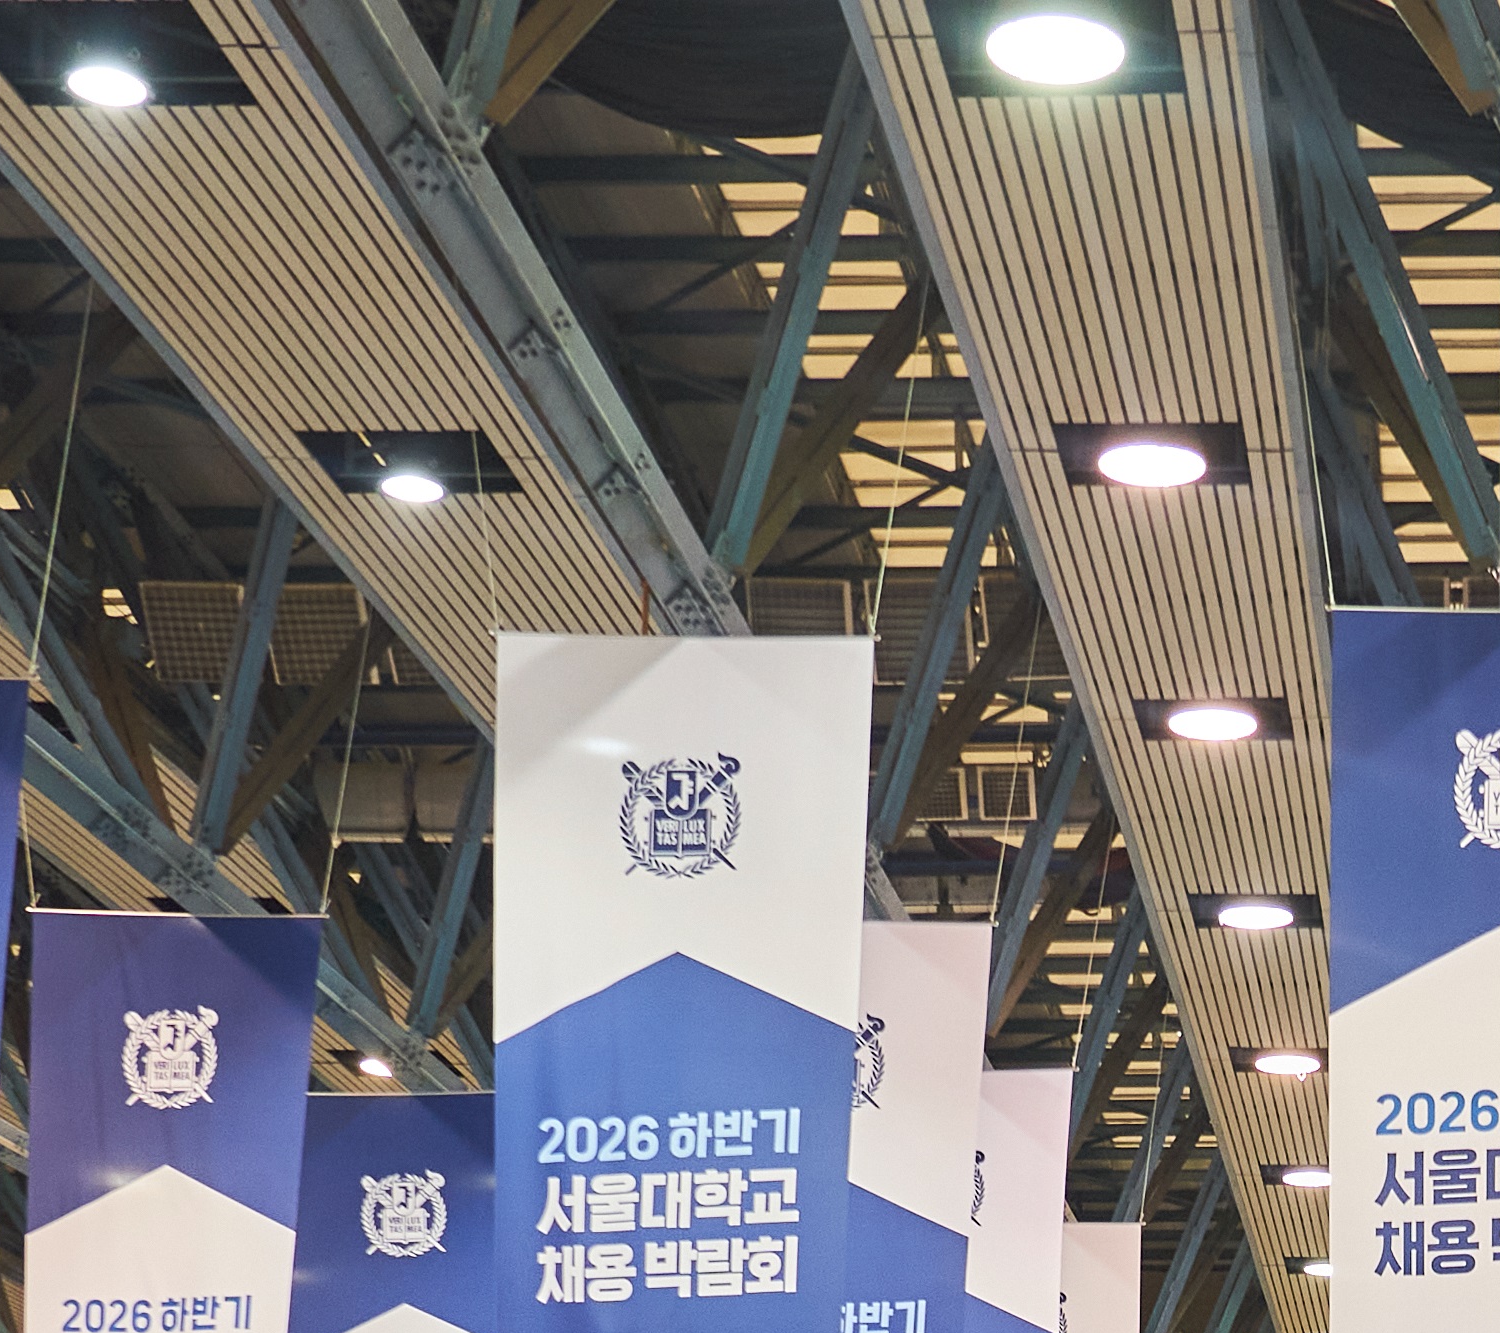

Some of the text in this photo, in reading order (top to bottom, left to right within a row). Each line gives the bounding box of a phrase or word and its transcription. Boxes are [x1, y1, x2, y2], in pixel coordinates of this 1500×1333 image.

[538, 1108, 800, 1165] 2026 하반기
[1376, 1089, 1499, 1135] 2026
[535, 1168, 801, 1236] 서울대학교
[536, 1235, 798, 1304] 채용 박람회
[1375, 1220, 1479, 1276] 채용
